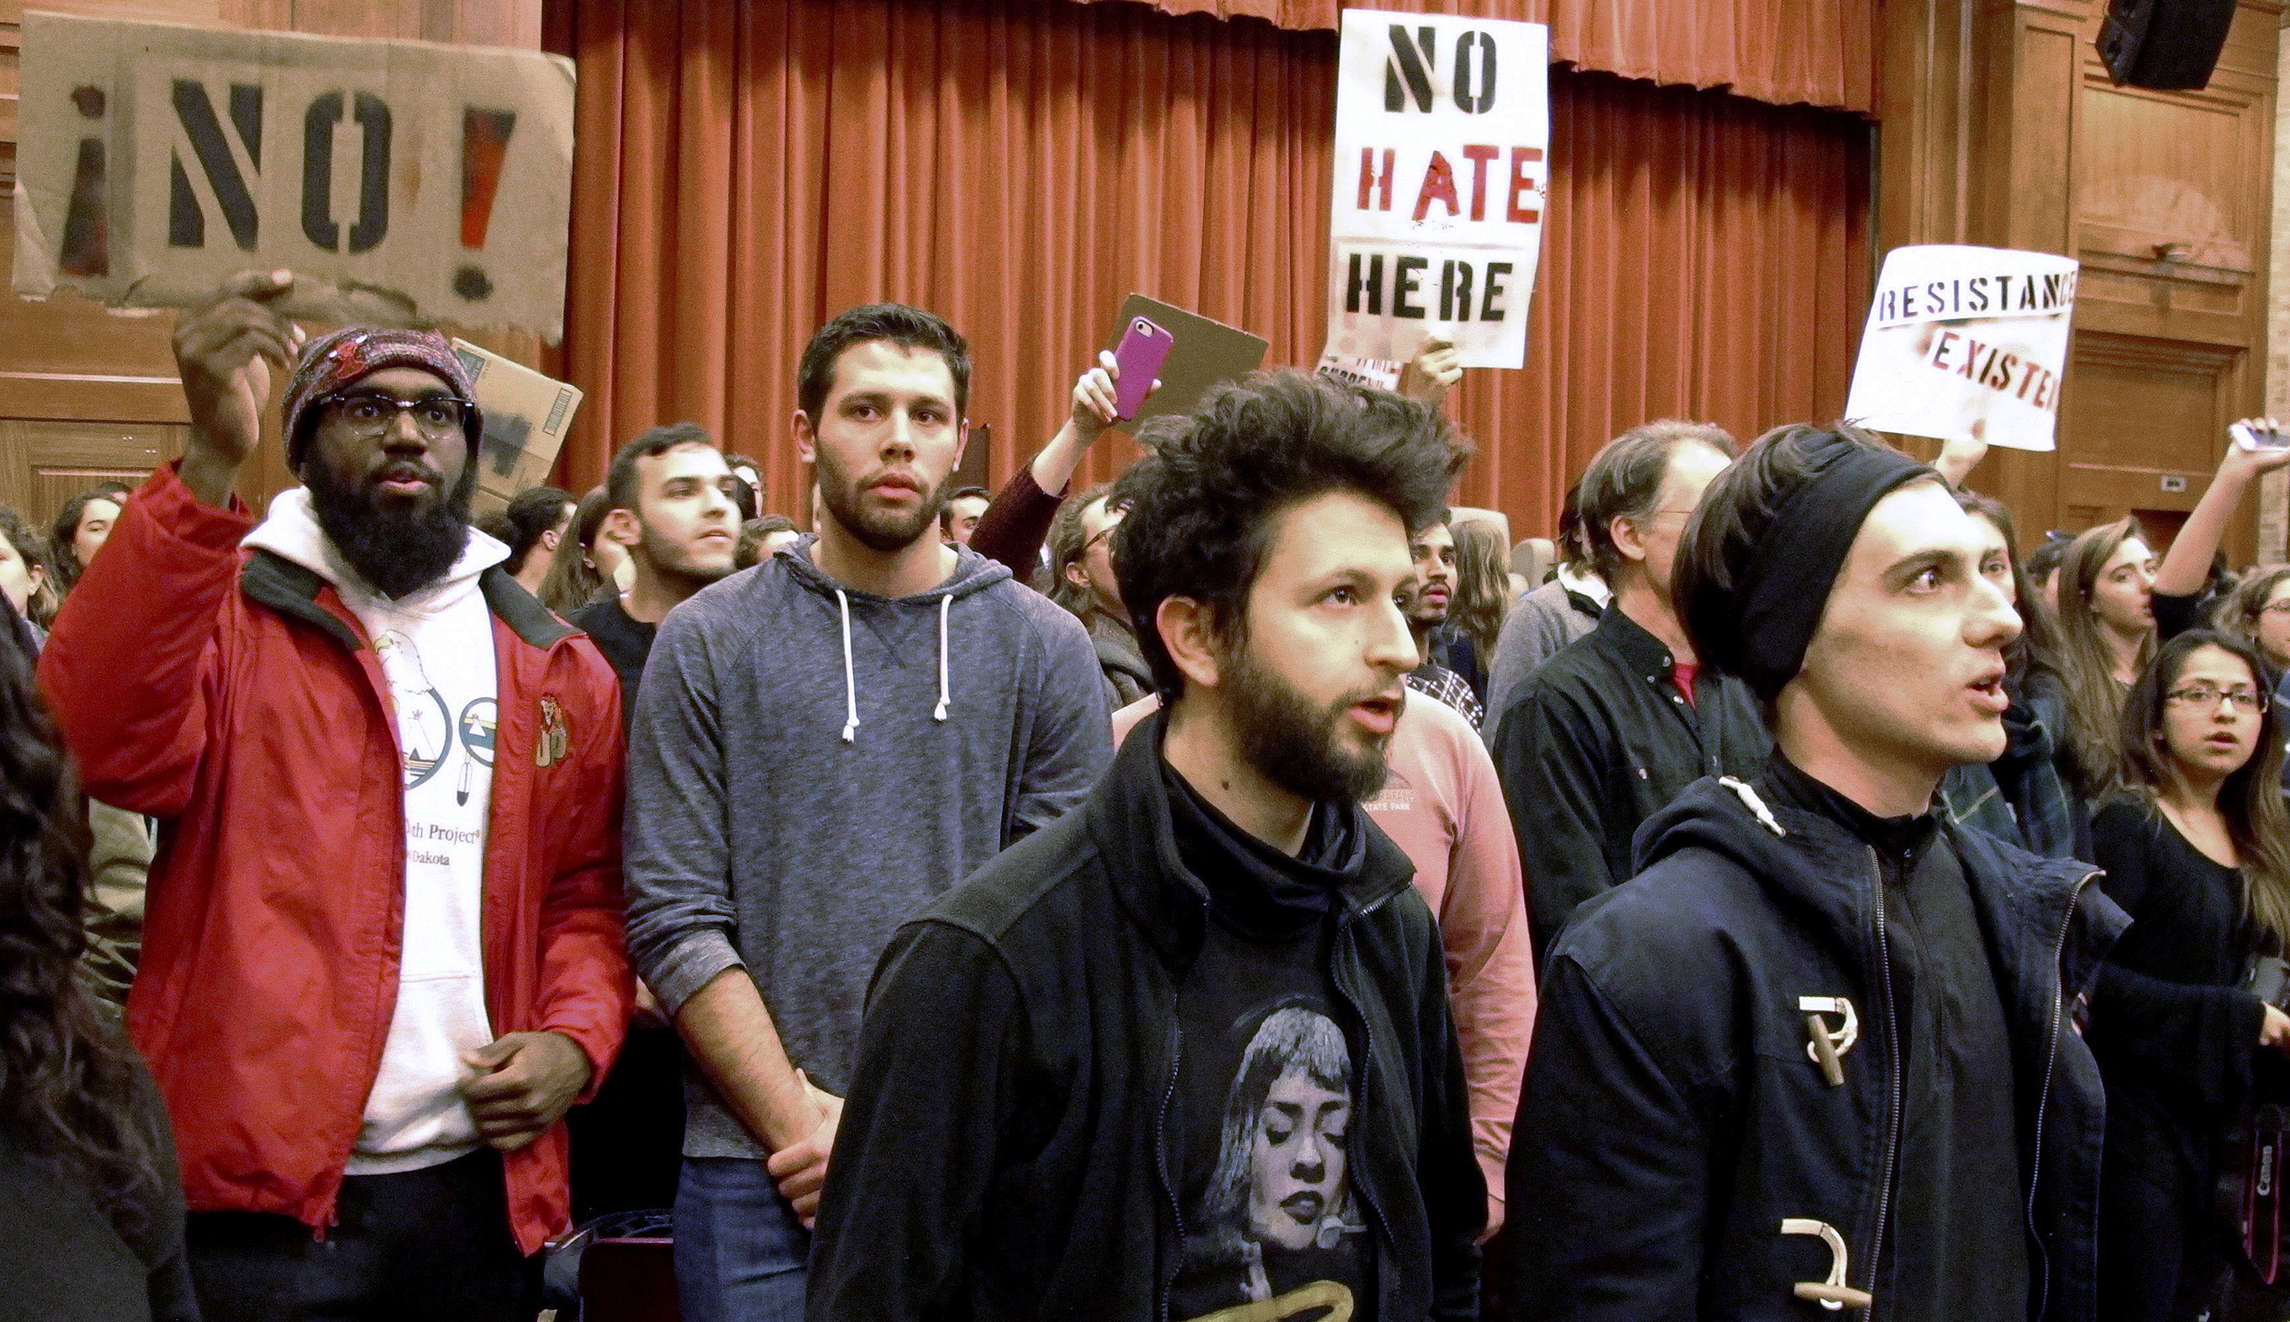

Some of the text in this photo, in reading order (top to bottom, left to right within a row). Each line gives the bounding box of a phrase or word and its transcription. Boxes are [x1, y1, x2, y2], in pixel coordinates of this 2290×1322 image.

[1384, 24, 1496, 114] NO
[1357, 144, 1543, 223] HATE
[1345, 253, 1513, 322] HERE
[1879, 271, 2079, 321] RESISTANCE
[1390, 802, 1411, 811] PARK
